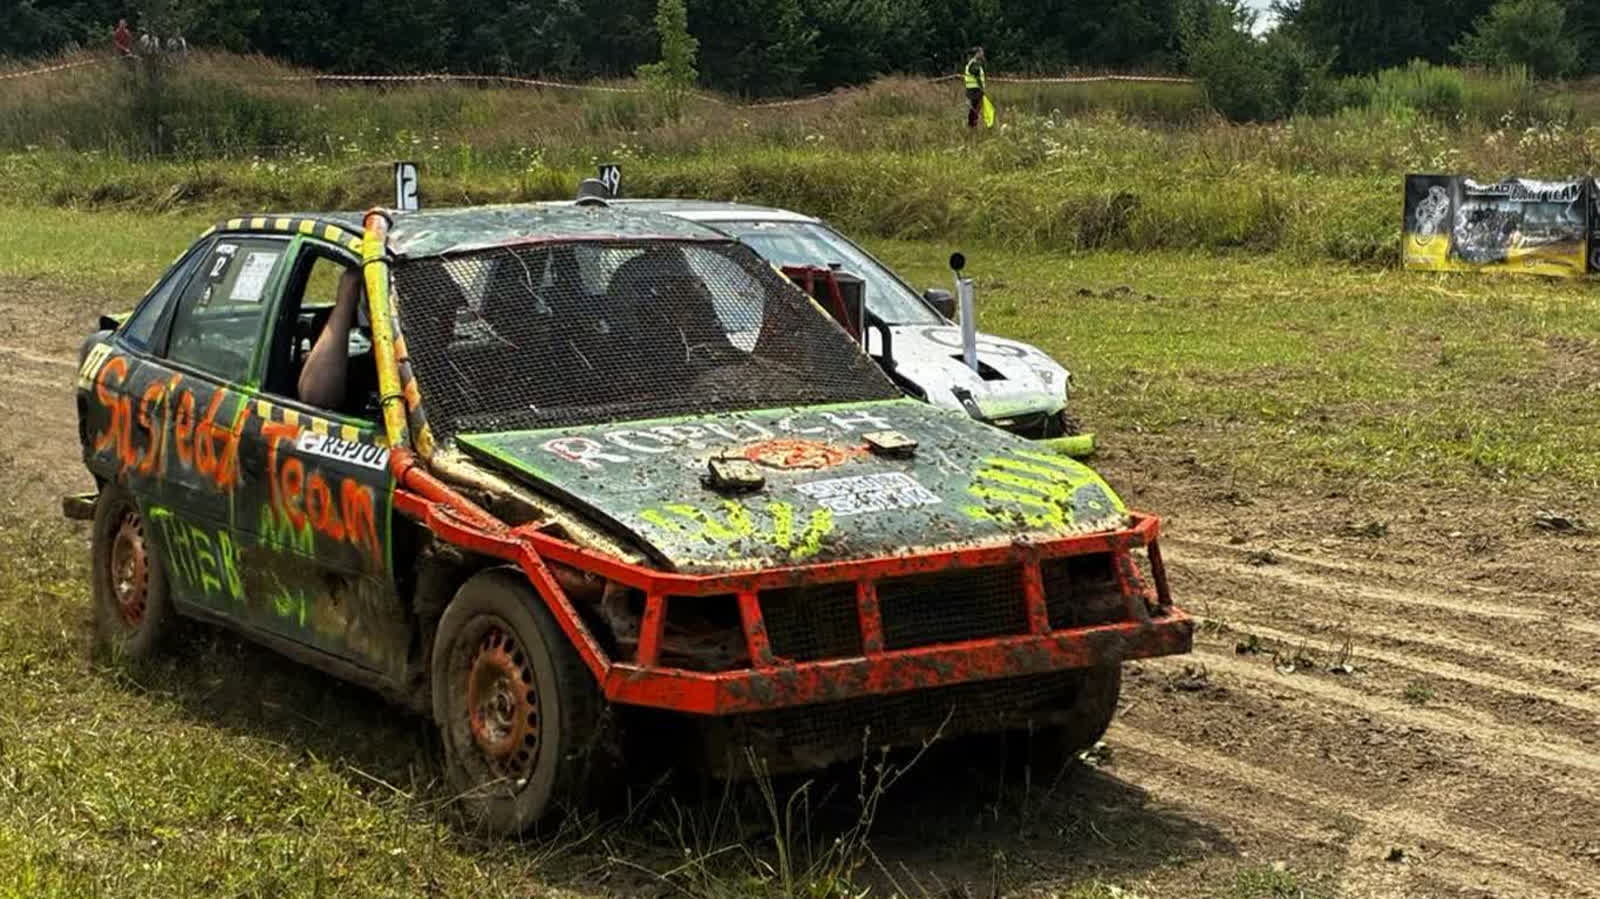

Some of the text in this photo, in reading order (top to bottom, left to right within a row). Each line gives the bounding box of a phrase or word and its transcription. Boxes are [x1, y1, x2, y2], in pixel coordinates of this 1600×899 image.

[396, 162, 418, 209] 12
[602, 165, 621, 196] 49
[320, 434, 384, 466] REPSOL
[261, 420, 383, 570] Team
